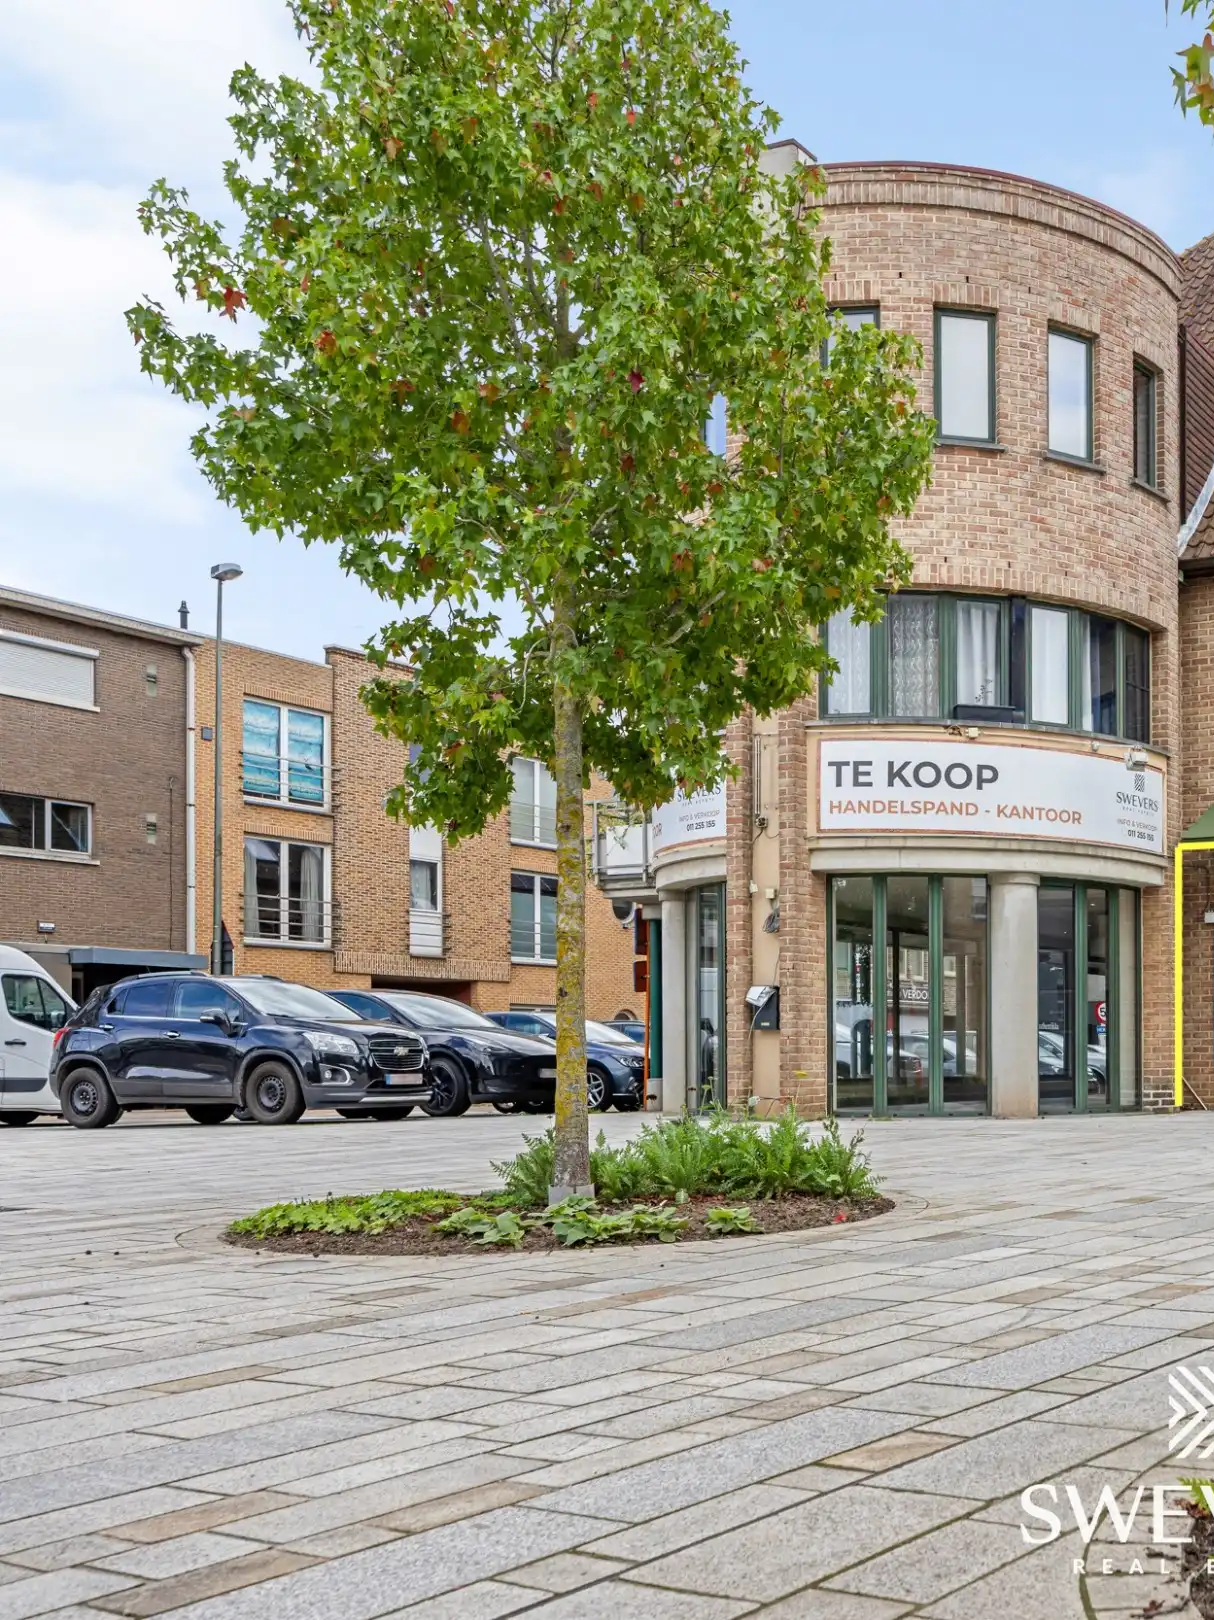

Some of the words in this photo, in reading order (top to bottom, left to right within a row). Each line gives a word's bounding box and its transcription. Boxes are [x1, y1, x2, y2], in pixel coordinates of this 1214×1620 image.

[828, 761, 873, 788] TE
[887, 761, 999, 790] KOOP
[829, 800, 979, 816] HANDELSPAND
[997, 804, 1082, 825] KANTOOR
[1116, 792, 1159, 812] SWEVERS
[1136, 821, 1157, 832] VERKOOP
